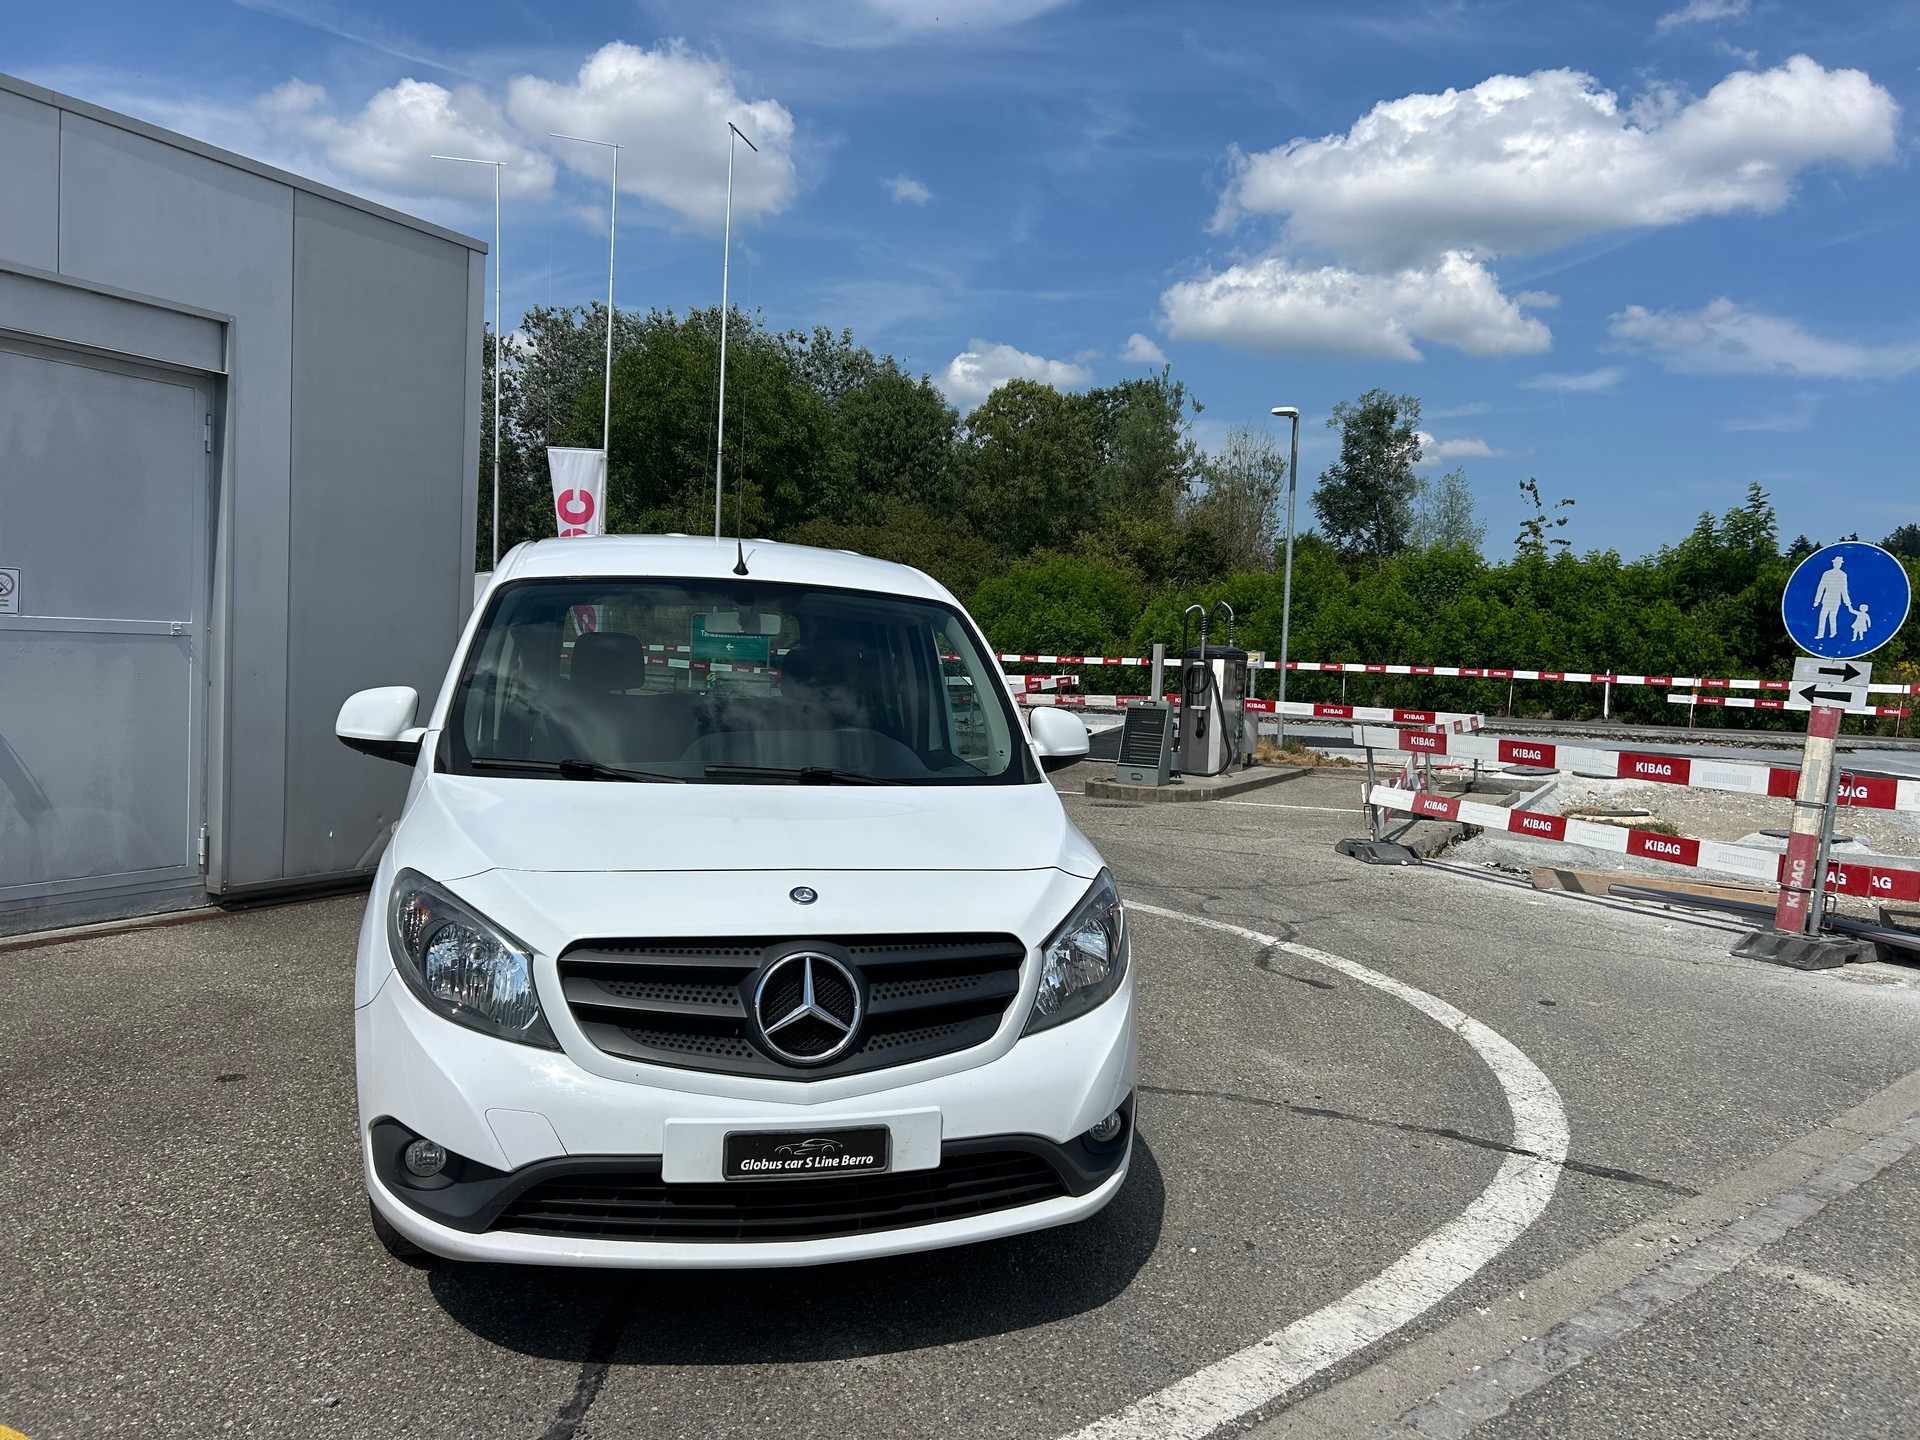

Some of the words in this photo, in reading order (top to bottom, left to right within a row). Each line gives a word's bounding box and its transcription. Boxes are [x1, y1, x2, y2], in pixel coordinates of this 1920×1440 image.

[1403, 713, 1425, 721] KIBAG
[1410, 736, 1435, 747] KIBAG
[1512, 748, 1541, 761] KIBAG
[1635, 762, 1672, 776] KIBAG
[1837, 784, 1868, 799] BAG
[1423, 800, 1448, 813] KIBAG
[1522, 818, 1552, 832] KIBAG
[1644, 839, 1681, 855] KIBAG
[741, 1157, 783, 1170] Globus
[784, 1159, 804, 1168] car
[805, 1157, 812, 1168] S
[814, 1156, 840, 1168] Line
[841, 1155, 874, 1166] Berro
